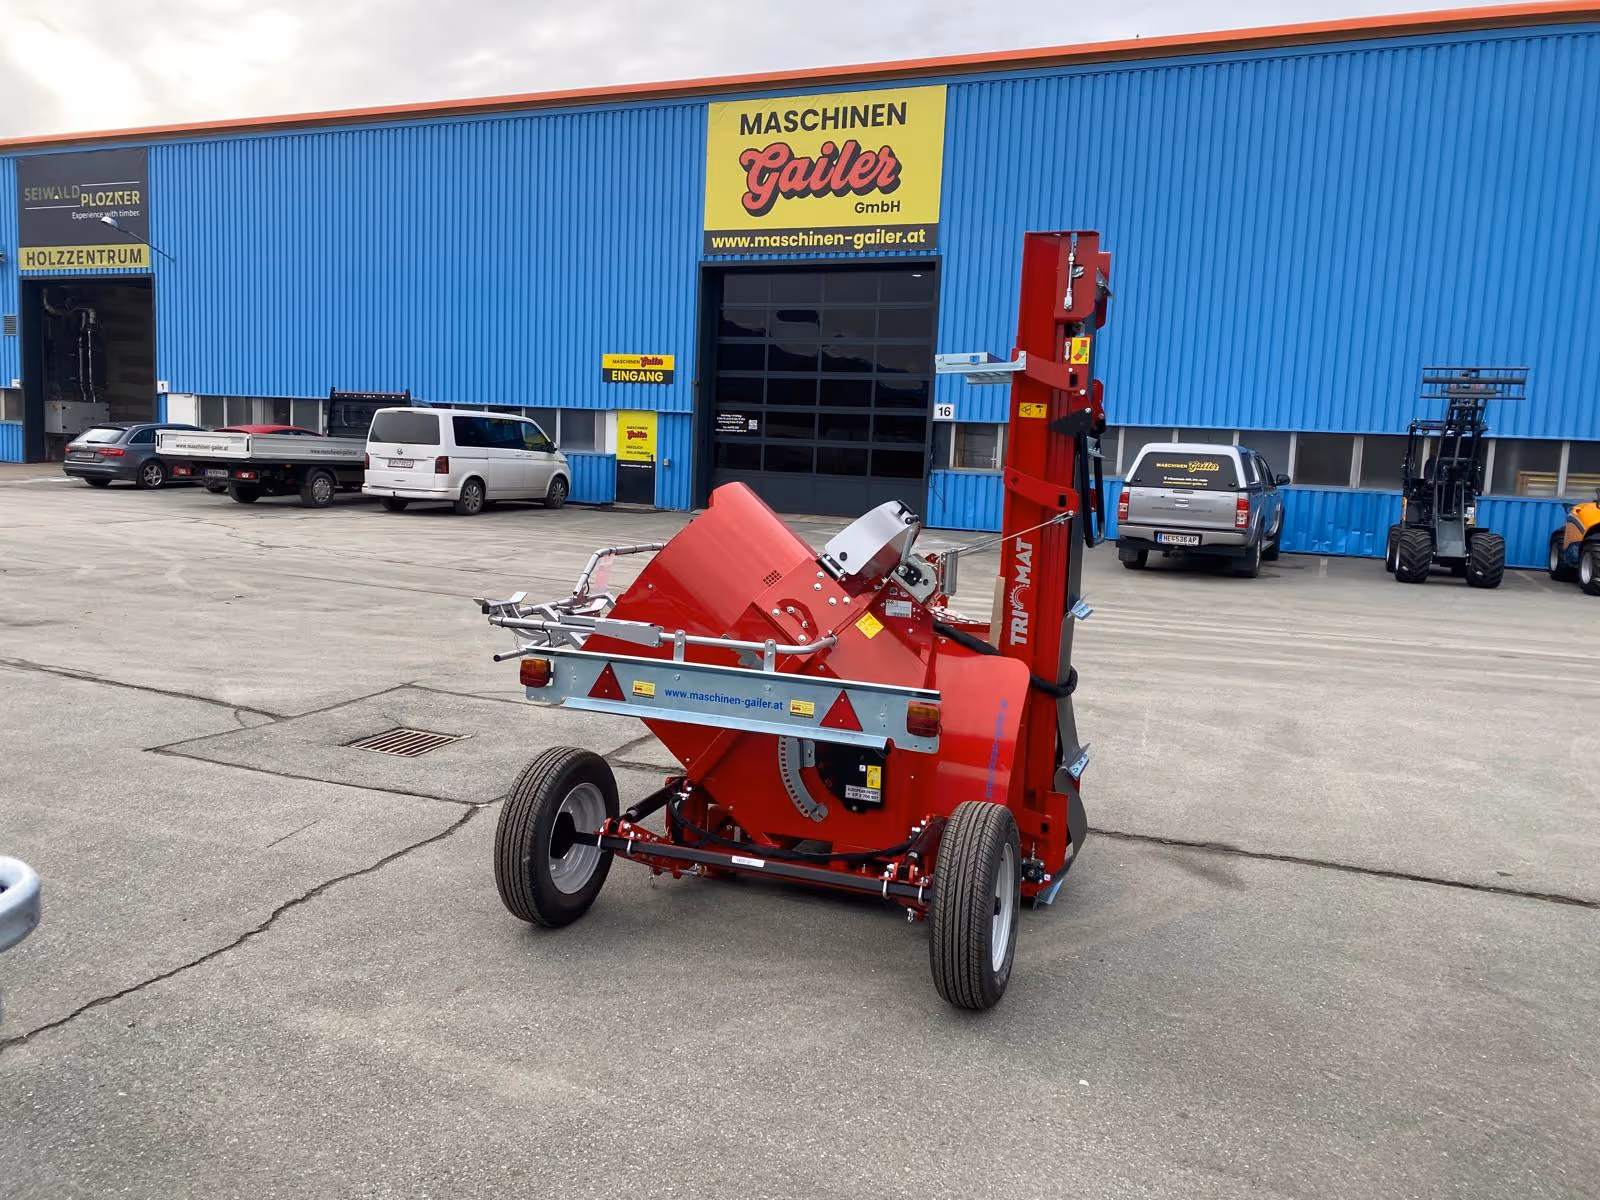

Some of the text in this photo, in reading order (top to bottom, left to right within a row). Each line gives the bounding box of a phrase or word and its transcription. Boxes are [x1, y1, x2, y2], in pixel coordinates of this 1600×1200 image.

[739, 101, 908, 135] MASCHINEN
[739, 139, 903, 218] Gailer
[25, 185, 80, 201] SEIWALD
[81, 190, 140, 207] PLOZNER
[72, 211, 103, 220] Experience
[854, 200, 901, 214] GmbH
[711, 228, 926, 250] www.maschinen-gailer.at
[26, 248, 142, 266] HOLZZENTRUM
[611, 370, 664, 382] EINGANG
[938, 406, 951, 417] 16
[664, 688, 784, 711] www.maschinen-gailer.at
